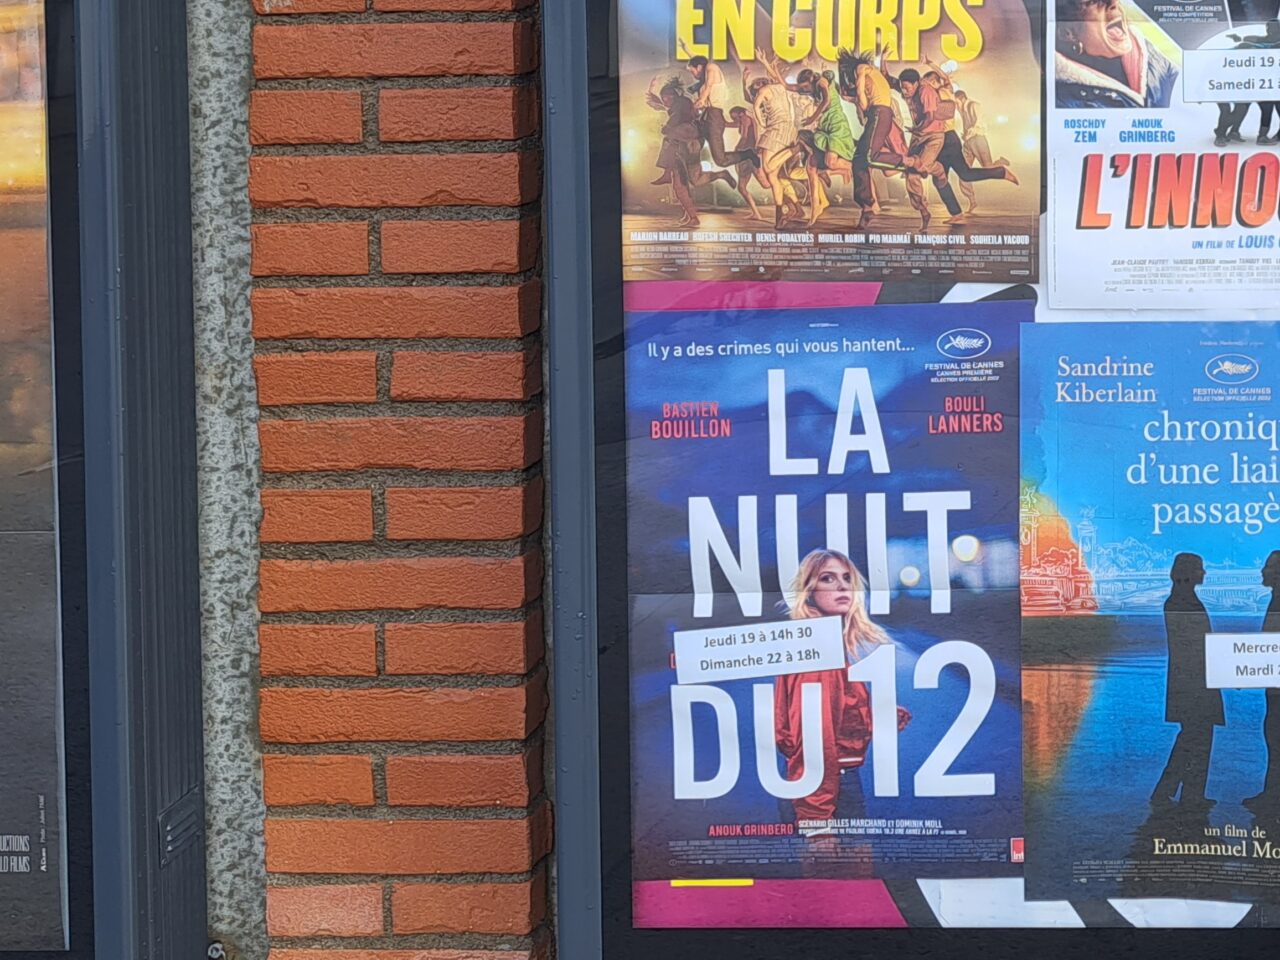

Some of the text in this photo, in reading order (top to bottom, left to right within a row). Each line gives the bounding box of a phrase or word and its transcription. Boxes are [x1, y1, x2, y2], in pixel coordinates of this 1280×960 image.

[1222, 57, 1255, 68] Jeudi
[1259, 56, 1275, 67] 19
[1209, 79, 1255, 90] Samedi
[1259, 79, 1274, 89] 21
[1064, 118, 1106, 129] ROSCHDY
[1131, 118, 1163, 129] ANOUK
[1074, 130, 1097, 143] ZEM
[1119, 130, 1175, 142] GRINBERG
[1238, 235, 1275, 249] LOUIS
[661, 344, 670, 360] y
[673, 344, 682, 356] a
[686, 342, 714, 357] des
[718, 341, 772, 356] crimes
[776, 339, 799, 357] qui
[803, 342, 839, 353] vous
[1056, 354, 1155, 378] Sandrine
[1055, 382, 1158, 404] Kiberlain
[662, 402, 720, 418] BASTIEN
[945, 395, 985, 412] BOULI
[650, 418, 731, 440] BOUILLON
[768, 367, 891, 476] LA
[928, 412, 1003, 434] LANNERS
[1125, 452, 1221, 486] d'une
[688, 490, 971, 618] NUIT
[704, 627, 812, 648] Jeudi 19 à 14h 30
[700, 649, 820, 671] Dimanche 22 à 18h
[1235, 664, 1274, 676] Mardi
[670, 640, 997, 800] DU 12
[1153, 838, 1248, 858] Emmanuel
